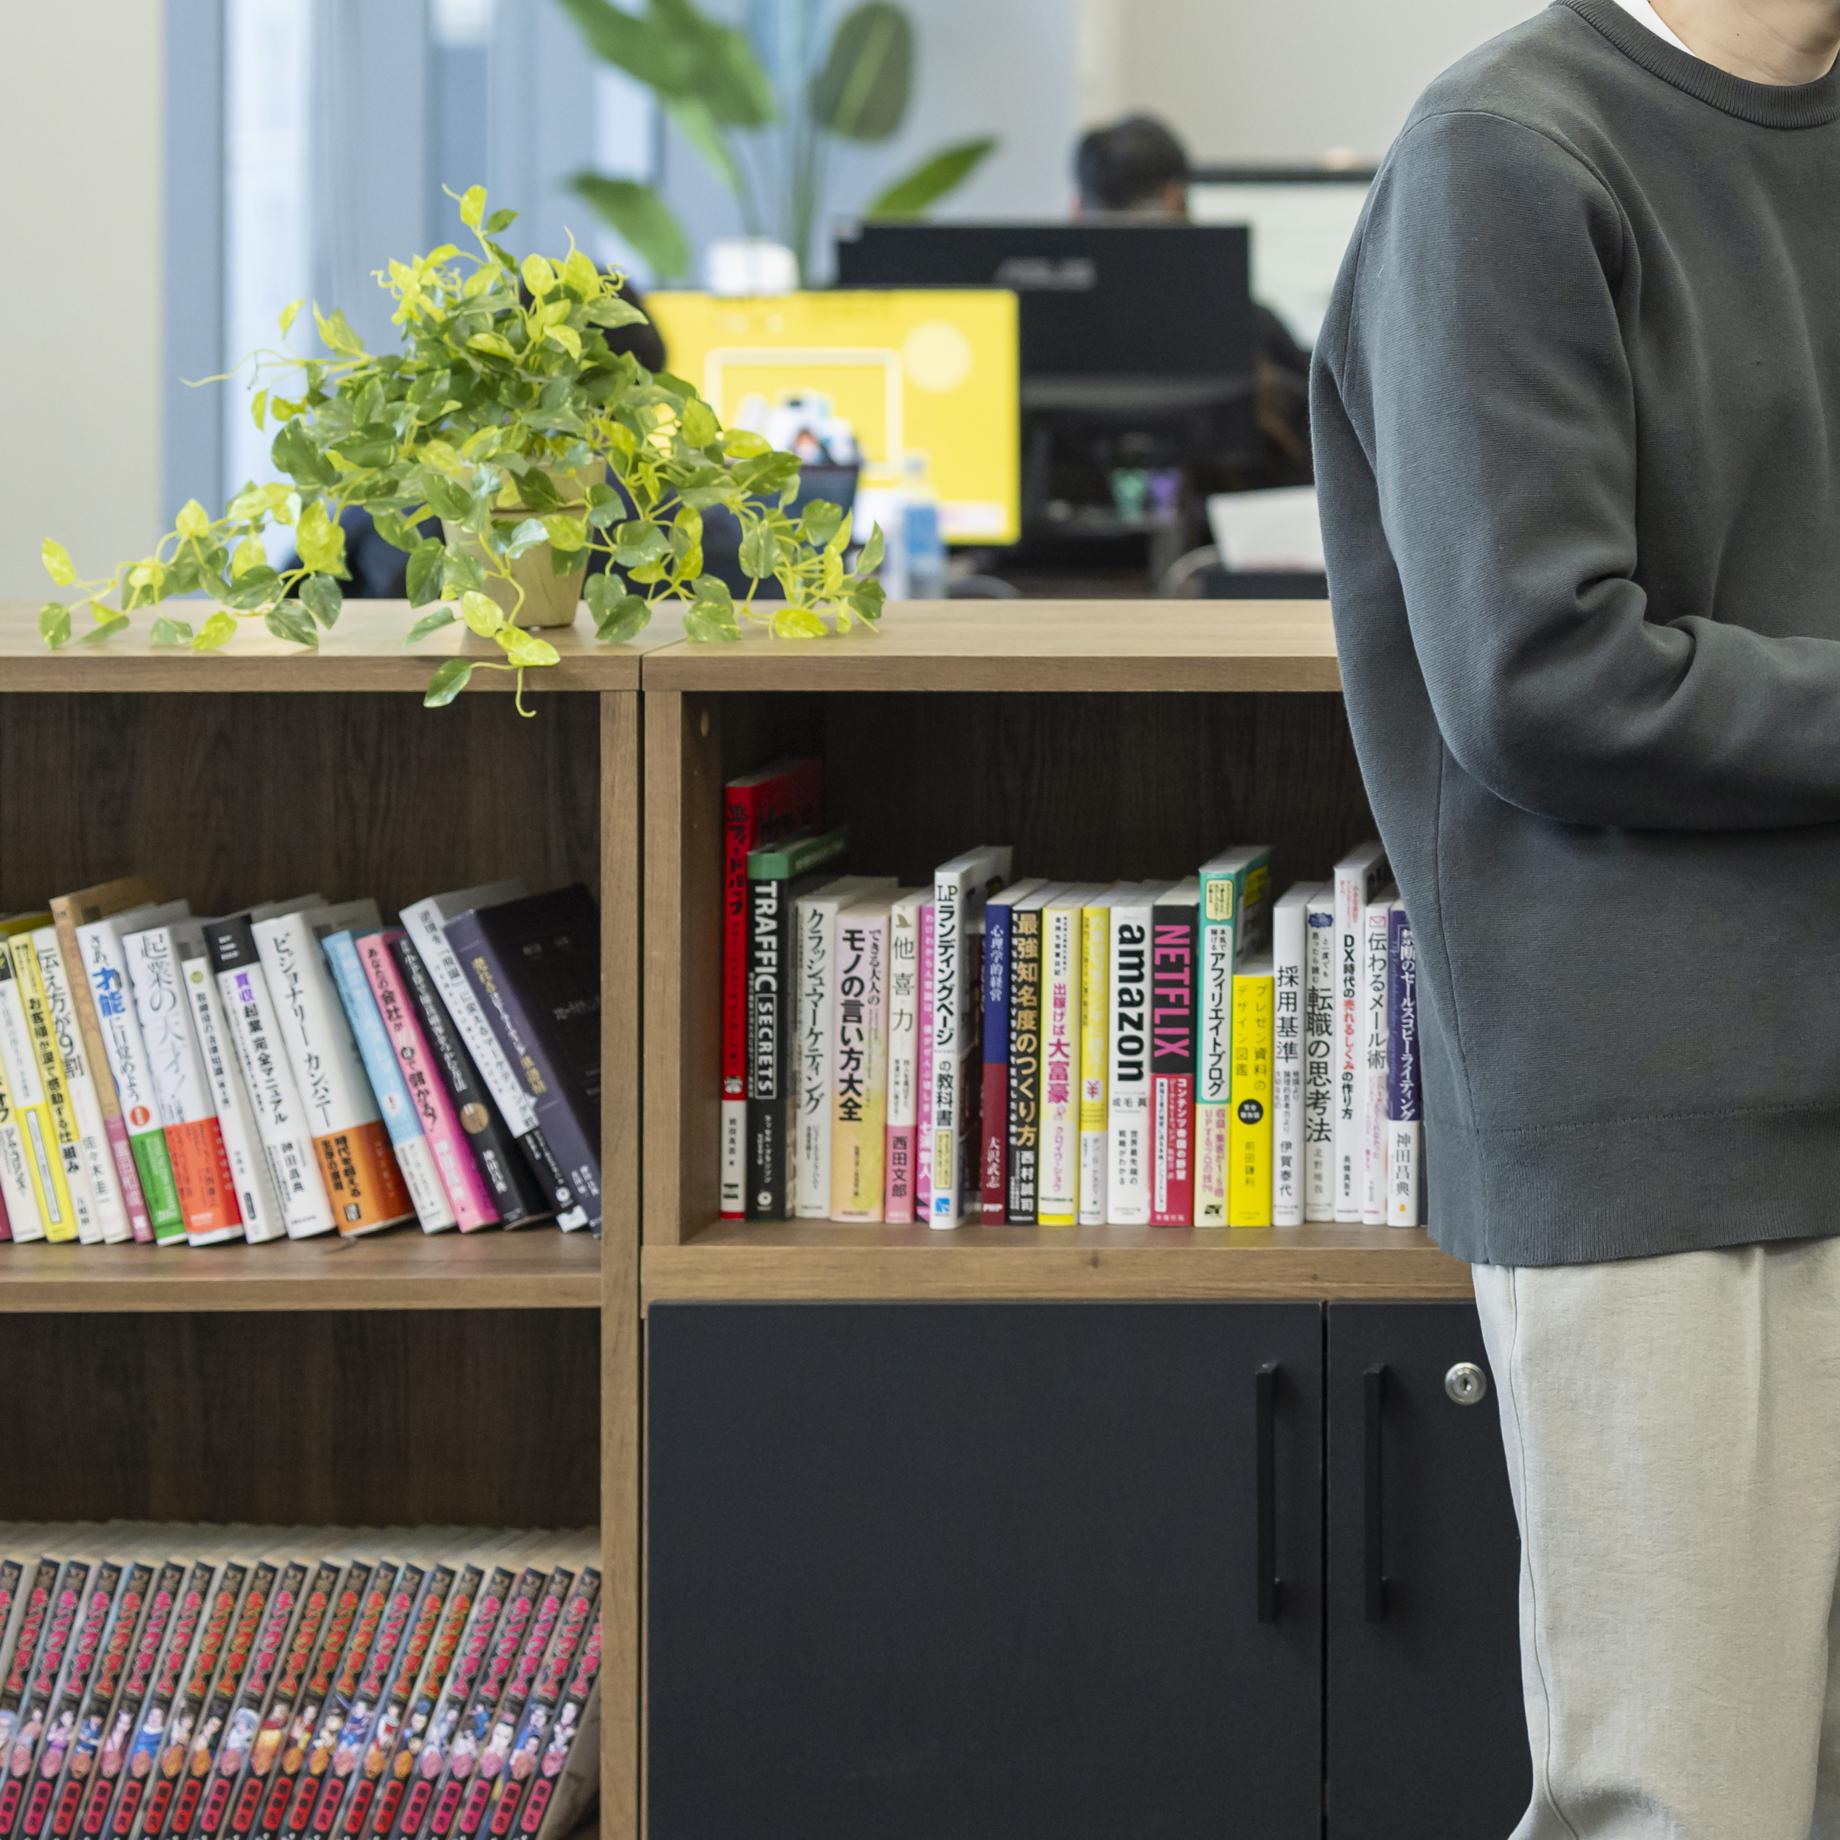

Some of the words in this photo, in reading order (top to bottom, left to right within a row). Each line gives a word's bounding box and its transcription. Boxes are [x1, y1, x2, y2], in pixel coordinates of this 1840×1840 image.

[754, 880, 778, 993] TRAFFIC
[1117, 923, 1145, 1082] amazon
[1153, 924, 1191, 1058] NETFLIX
[1367, 932, 1388, 1070] 伝わるメール術
[757, 1001, 775, 1092] SECRETS
[839, 928, 866, 1122] モノの言い方大全
[1015, 913, 1039, 1147] 最強知名度のつくり方
[1207, 952, 1226, 1097] アフィリエイトブログ
[1276, 965, 1299, 1063] 採用基準
[1305, 986, 1333, 1143] 転職の思考法
